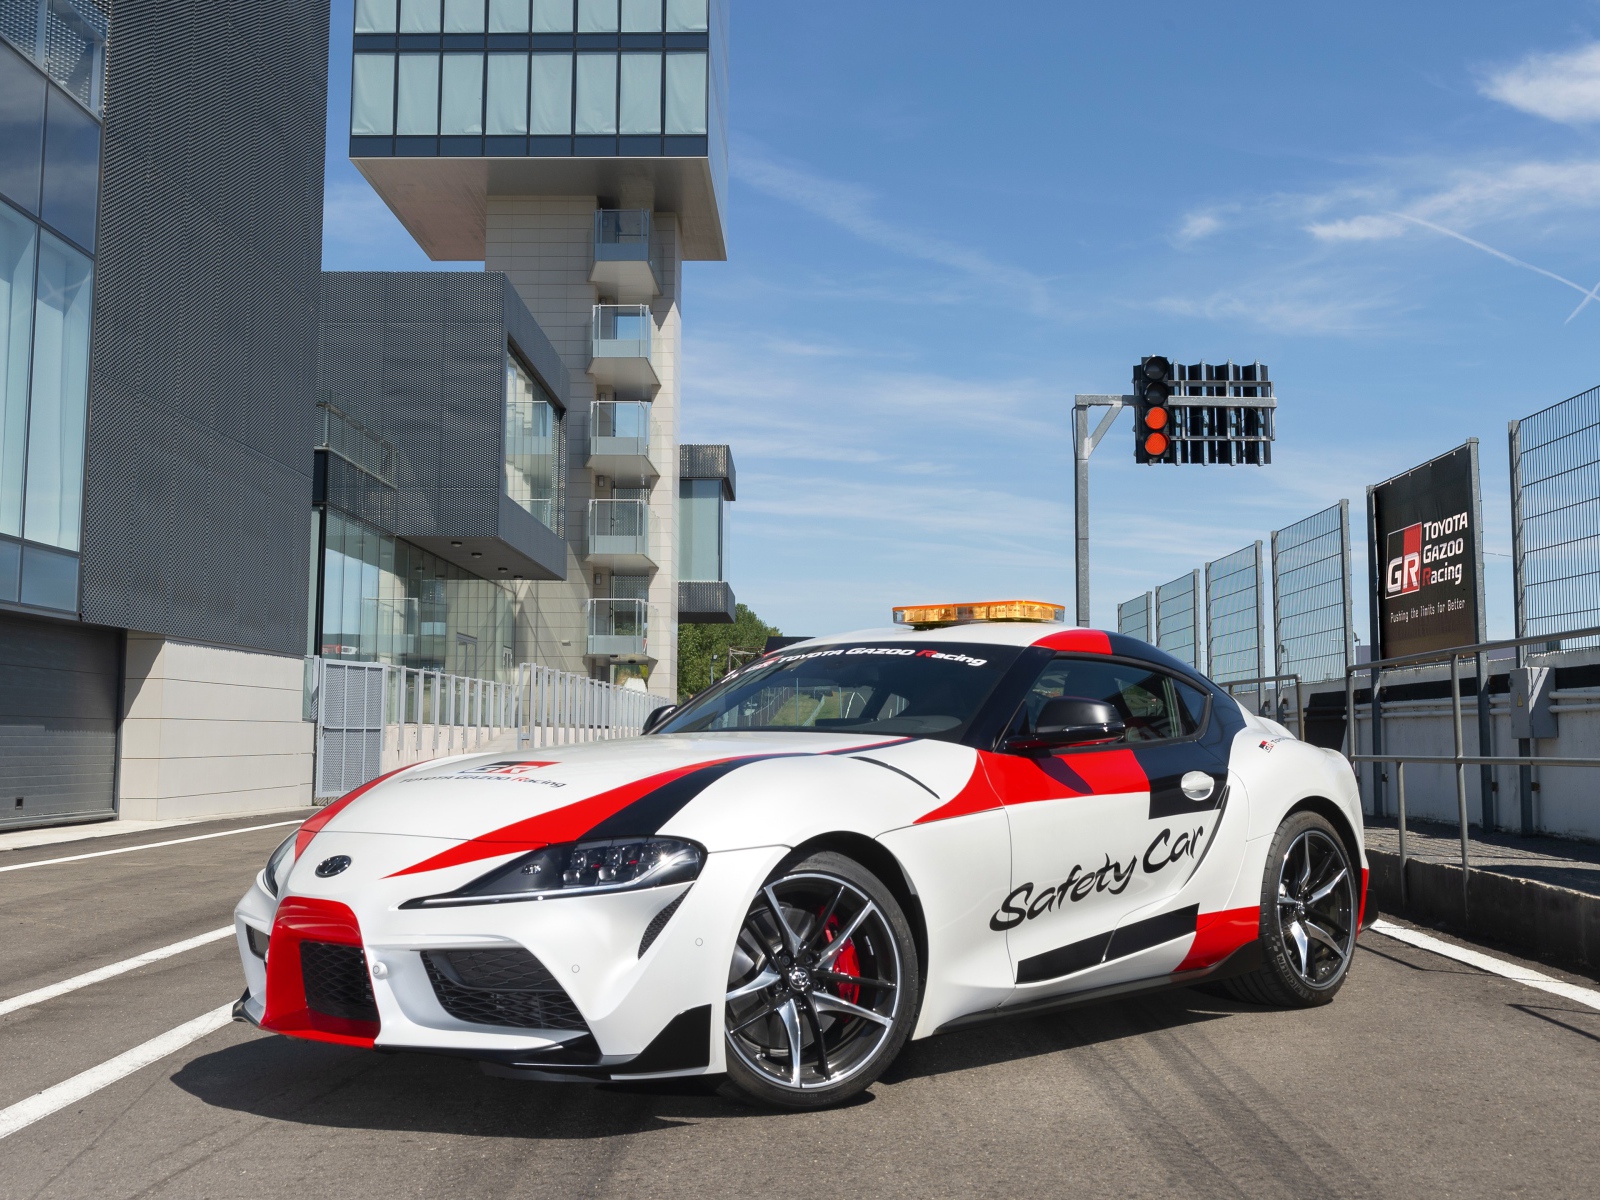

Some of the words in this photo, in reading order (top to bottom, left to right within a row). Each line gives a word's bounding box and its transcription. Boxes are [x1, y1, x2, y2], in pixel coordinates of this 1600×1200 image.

[1424, 512, 1468, 541] TOYOTA
[1423, 538, 1464, 564] GAZOO
[1387, 552, 1420, 593] GR
[1422, 562, 1462, 586] Racing
[1390, 611, 1409, 623] Pushing
[1410, 608, 1419, 619] the
[1420, 604, 1435, 617] limits
[1437, 602, 1446, 613] for
[1447, 598, 1466, 612] Better
[778, 650, 845, 664] TOYOTA
[845, 647, 916, 656] GAZOO
[916, 649, 988, 667] Racing
[511, 775, 567, 789] Racing
[989, 852, 1138, 932] Safety
[1142, 825, 1204, 874] Car
[1277, 953, 1302, 992] MICHELIN
